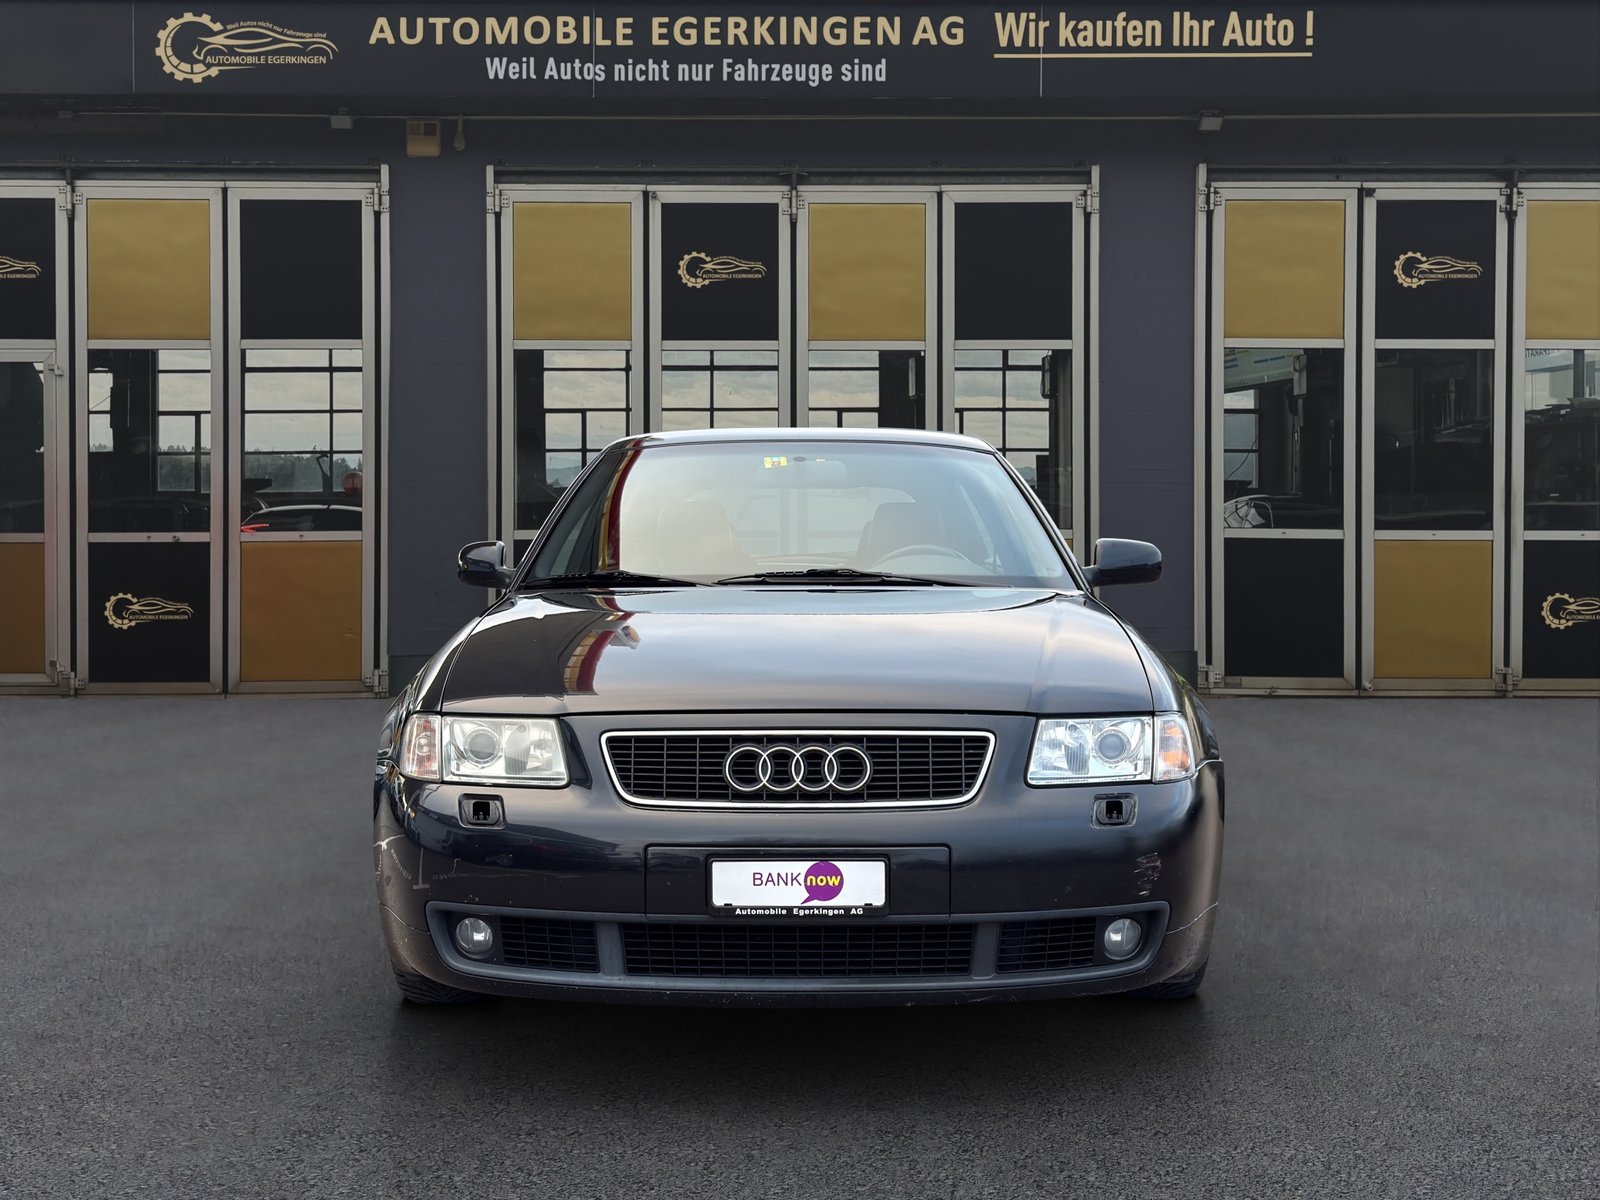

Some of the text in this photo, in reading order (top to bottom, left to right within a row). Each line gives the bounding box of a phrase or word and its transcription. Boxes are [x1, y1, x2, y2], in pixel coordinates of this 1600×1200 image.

[226, 22, 239, 31] Weil
[257, 21, 273, 29] nicht
[272, 25, 283, 33] nur
[283, 28, 313, 38] Fahrzeuge
[368, 15, 965, 46] AUTOMOBILE EGERKINGEN AG
[994, 12, 1050, 48] Wir
[1058, 11, 1163, 48] kaufen
[1172, 11, 1216, 47] Ihr
[1221, 11, 1295, 47] Auto
[205, 55, 327, 65] AUTOMOBILE EGERKINGEN
[485, 57, 887, 87] Weil Autos nicht nur Fahrzeuge sind
[752, 872, 841, 887] BANK now
[735, 907, 864, 916] Automobile Egerkingen AG
